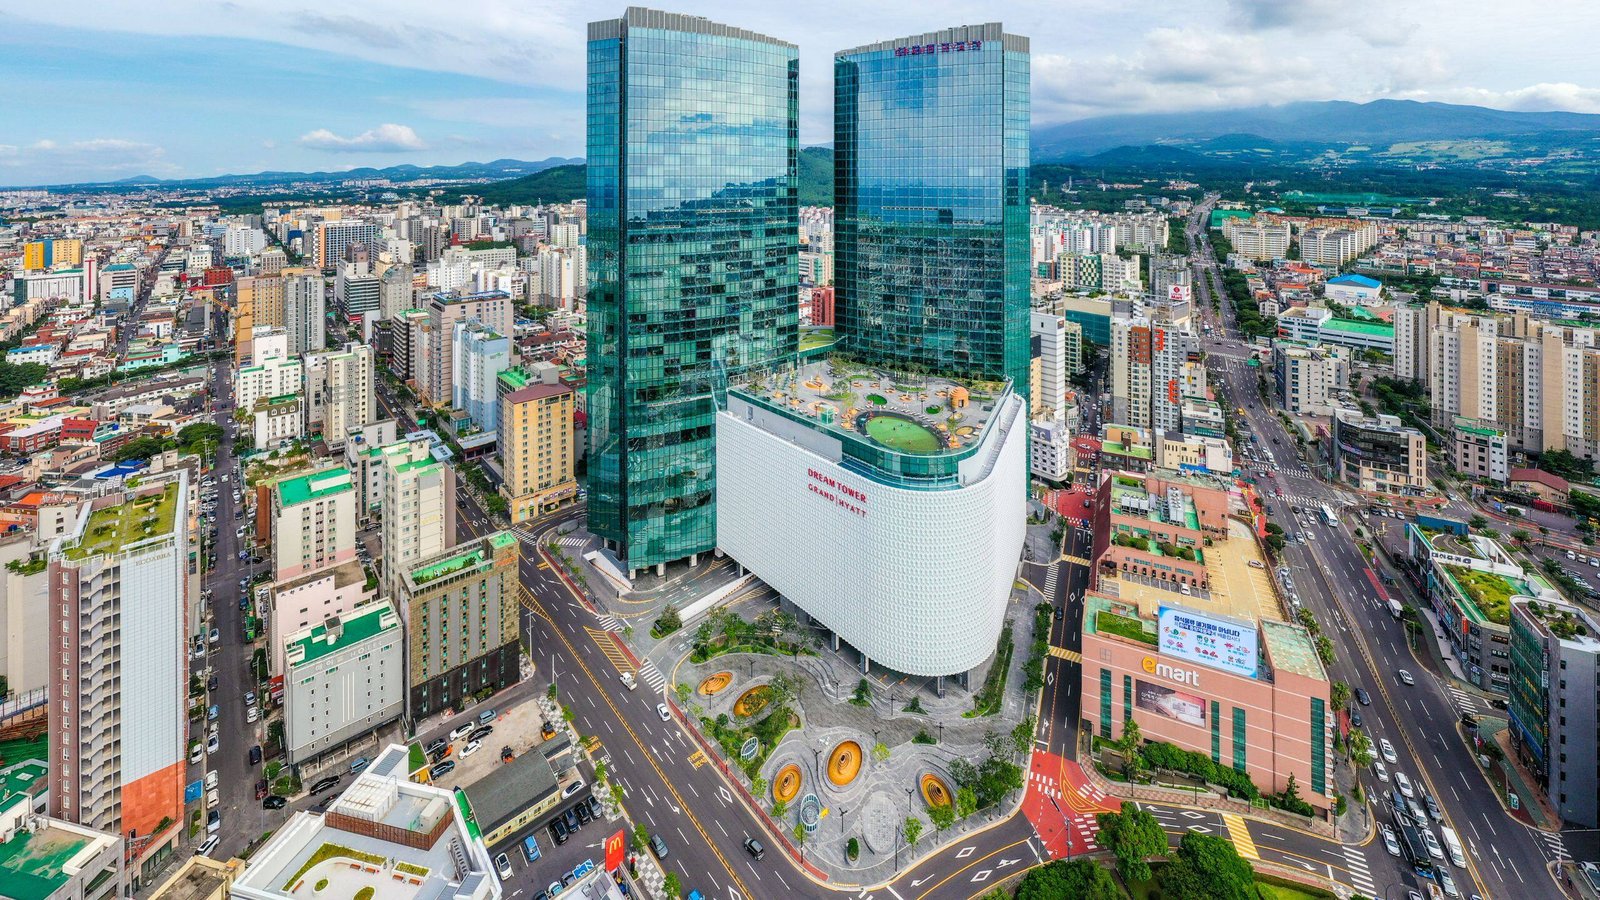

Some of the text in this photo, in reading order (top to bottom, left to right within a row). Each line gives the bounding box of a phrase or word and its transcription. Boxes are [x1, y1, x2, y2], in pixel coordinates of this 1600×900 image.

[808, 468, 866, 503] DREAM TOWER
[808, 483, 866, 518] GRAND HYATT
[1142, 656, 1200, 687] emart
